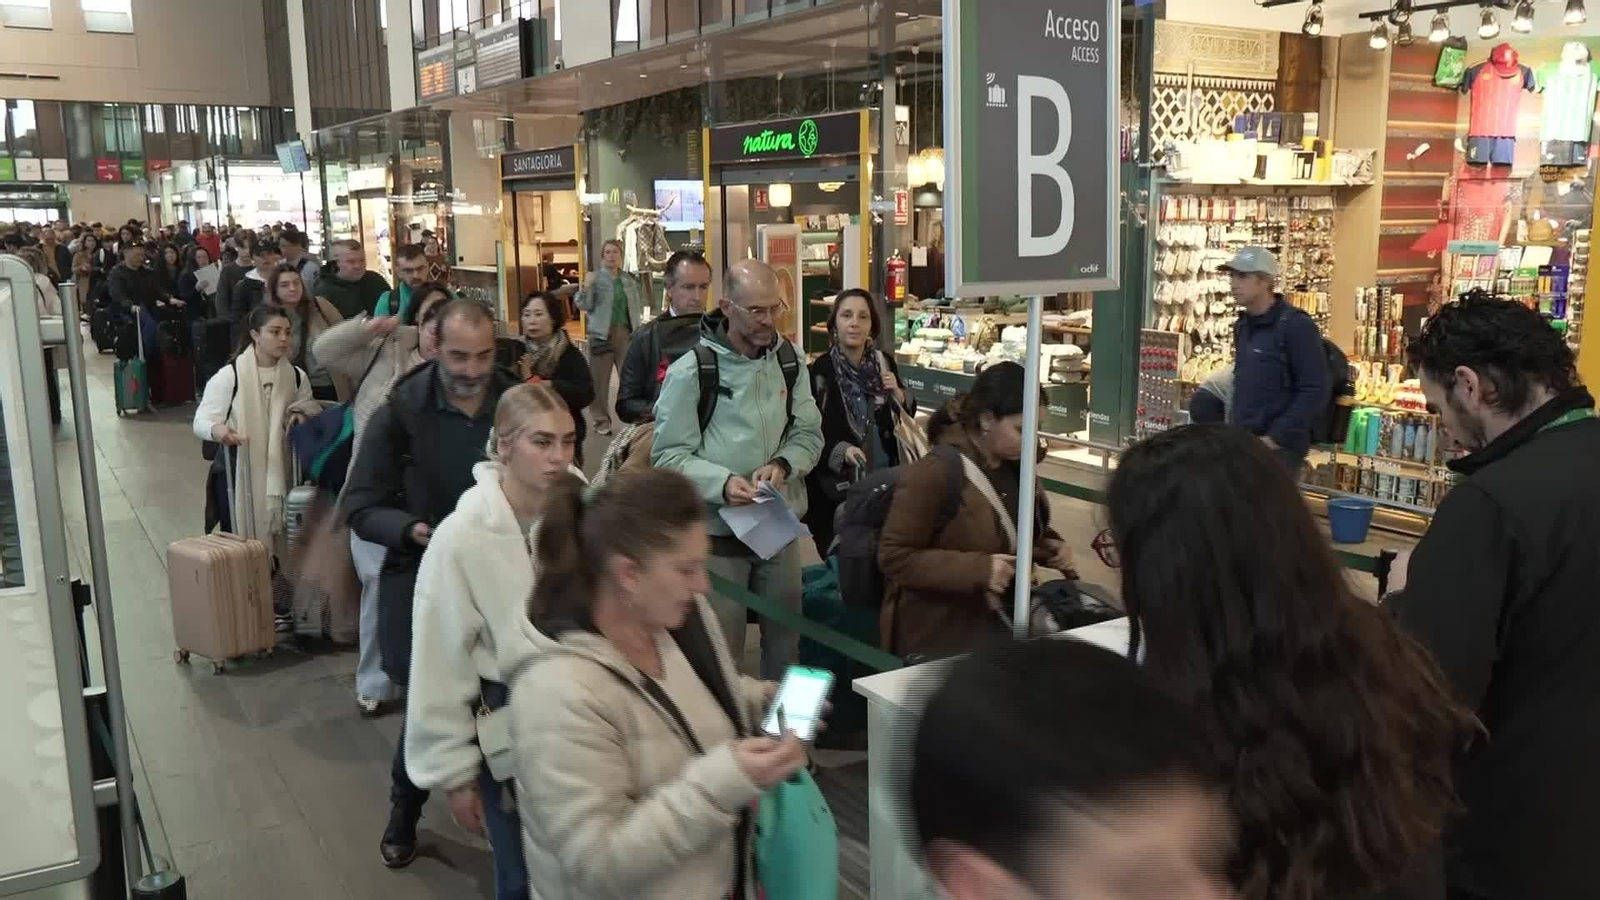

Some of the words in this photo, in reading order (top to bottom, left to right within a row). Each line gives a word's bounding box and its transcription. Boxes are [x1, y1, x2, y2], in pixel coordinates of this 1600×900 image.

[1044, 9, 1100, 42] Acceso
[1071, 46, 1100, 64] ACCESS
[743, 129, 796, 155] natura
[513, 153, 563, 172] SANTAGLORIA
[1018, 75, 1075, 257] B
[1080, 263, 1099, 274] adif
